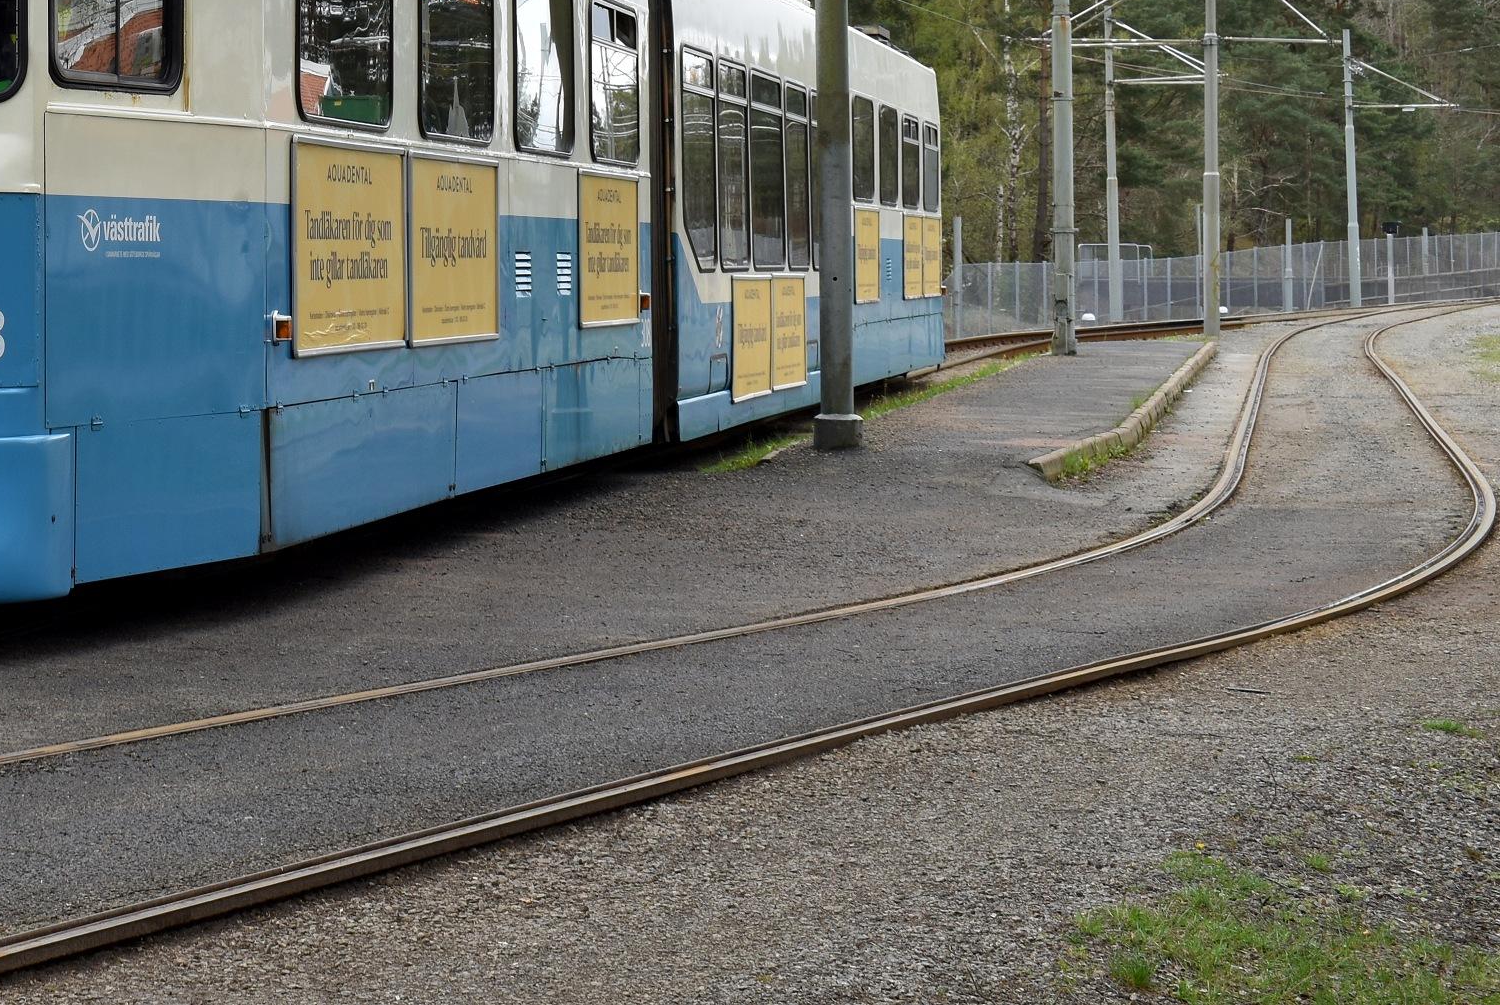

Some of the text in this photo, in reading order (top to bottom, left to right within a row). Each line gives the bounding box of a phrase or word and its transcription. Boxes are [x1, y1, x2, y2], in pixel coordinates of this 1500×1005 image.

[326, 164, 372, 184] AQUADENTAL
[436, 176, 473, 194] AQUADENTAL
[103, 215, 161, 242] västtrafik
[305, 209, 391, 248] Tandläkaren för dig som
[420, 227, 487, 267] Tillgänglig tandvård
[310, 251, 388, 288] inte gillar tandläkaren
